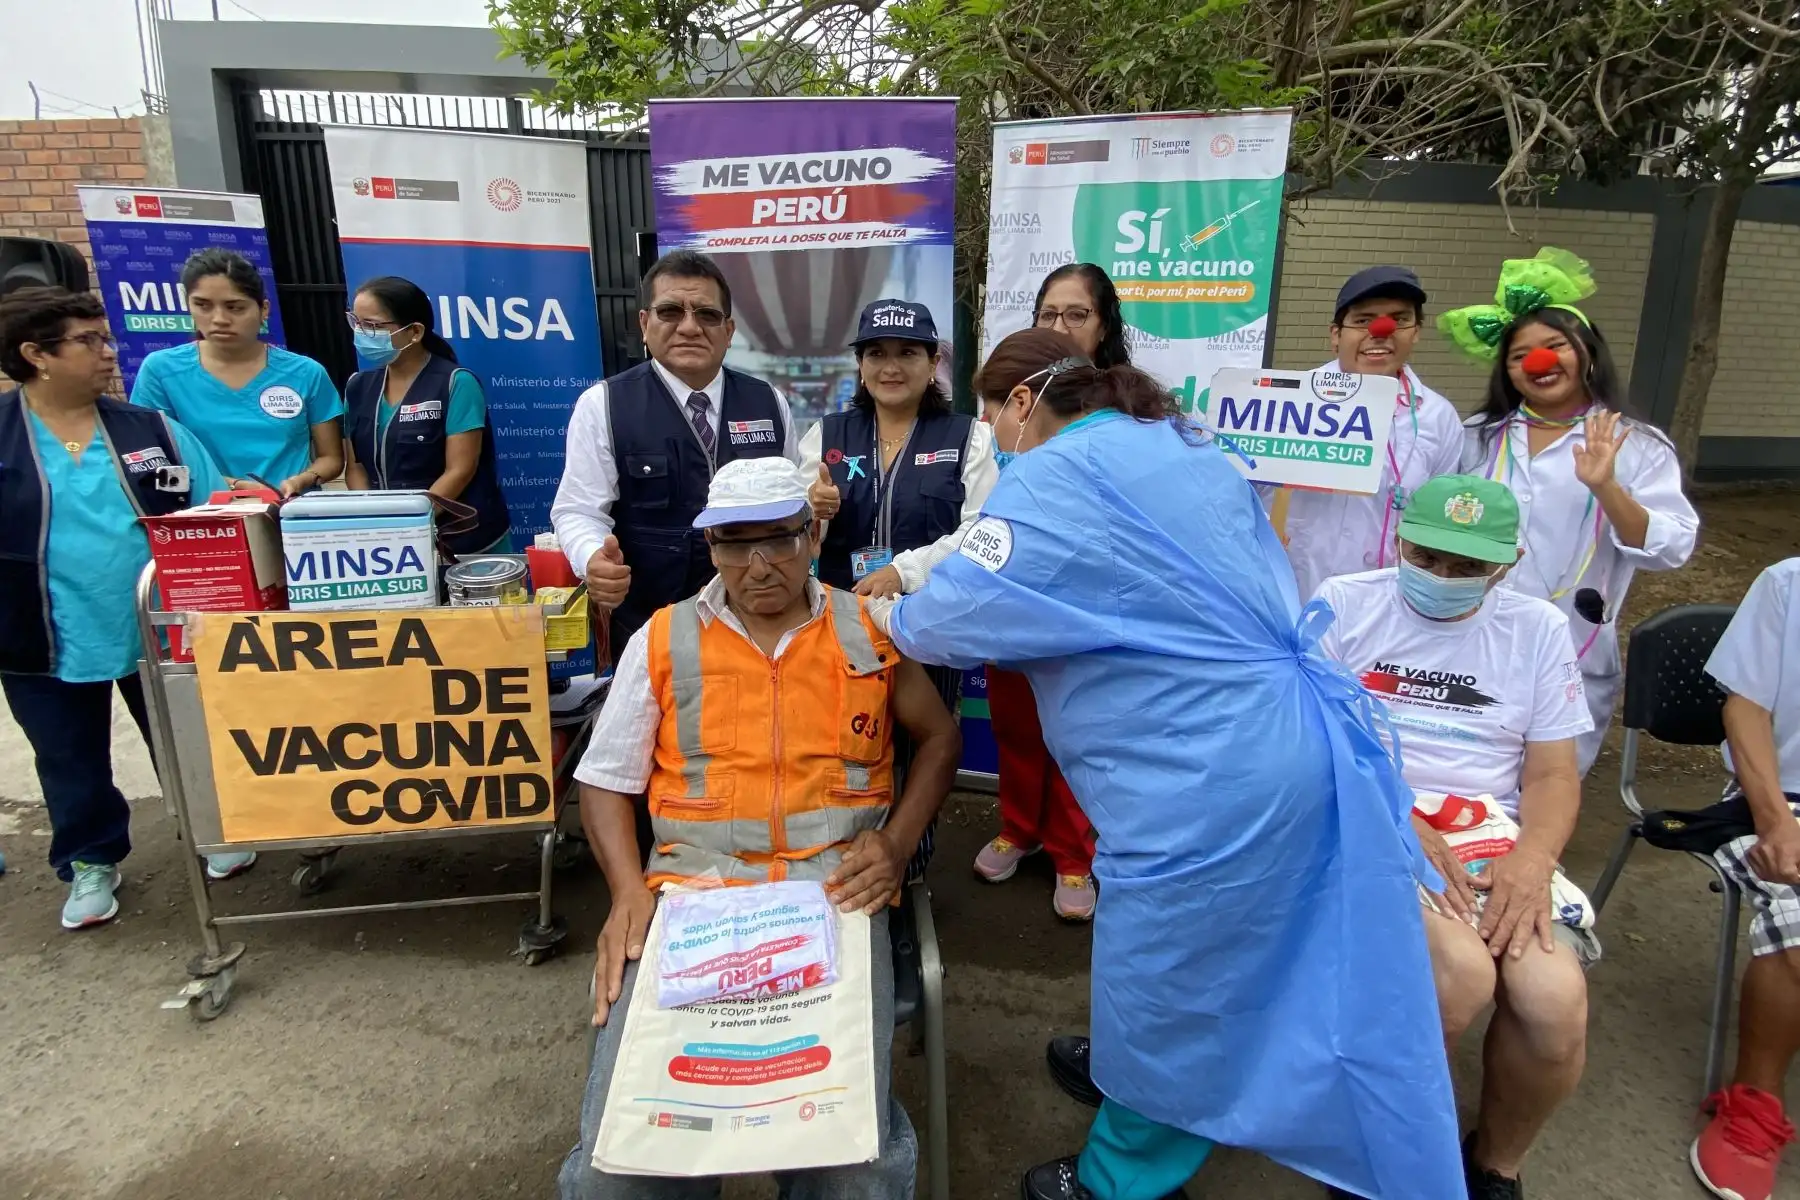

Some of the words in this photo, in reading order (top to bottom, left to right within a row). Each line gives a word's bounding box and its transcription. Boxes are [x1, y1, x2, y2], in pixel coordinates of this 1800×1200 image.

[1152, 139, 1190, 150] Siempre
[1165, 148, 1190, 157] pueblo
[702, 163, 749, 188] ME
[757, 156, 892, 185] VACUNO
[527, 190, 576, 199] BICENTENARIO
[752, 187, 847, 225] PERÚ
[990, 212, 1041, 227] MINSA
[706, 235, 769, 248] COMPLETA
[772, 235, 787, 245] LA
[791, 232, 825, 243] DOSIS
[828, 231, 852, 243] QUE
[857, 230, 869, 240] TE
[871, 228, 907, 239] FALTA
[1007, 227, 1026, 235] LIMA
[1115, 208, 1171, 258] Sí,
[1111, 260, 1152, 277] me
[1157, 259, 1255, 277] vacuno
[1147, 287, 1166, 299] por
[1185, 287, 1206, 299] por
[1207, 286, 1218, 297] el
[1219, 285, 1247, 297] Perú
[131, 317, 178, 330] DIRIS
[430, 295, 575, 341] INSA
[872, 311, 914, 328] Salud
[491, 376, 550, 388] Ministerio
[553, 377, 568, 387] de
[1323, 371, 1352, 381] DIRIS
[1315, 380, 1337, 388] LIMA
[1338, 381, 1357, 389] SUR
[1217, 396, 1373, 441] MINSA
[497, 426, 555, 437] Ministerio
[730, 432, 749, 445] DIRIS
[748, 432, 766, 444] LIMA
[1272, 440, 1320, 459] LIMA
[1324, 446, 1366, 464] SUR
[502, 477, 560, 487] Ministerio
[175, 527, 237, 540] DESLAB
[972, 528, 1002, 551] DIRIS
[962, 538, 980, 554] LIMA
[979, 547, 1003, 566] SUR
[284, 545, 425, 582] MINSA
[287, 585, 332, 601] DIRIS
[337, 582, 383, 598] LIMA
[387, 578, 424, 594] SUR
[578, 658, 592, 667] de
[1373, 661, 1401, 676] ME
[1405, 666, 1477, 687] VACUNO
[430, 667, 532, 716] DE
[1395, 681, 1449, 700] PERÚ
[851, 711, 879, 740] G4S
[228, 718, 541, 777] VACUNA
[330, 772, 551, 826] COVID
[750, 914, 759, 923] y
[758, 904, 800, 918] seguras
[715, 915, 749, 928] salvan
[769, 915, 814, 928] vacunas
[720, 928, 731, 938] la
[733, 923, 767, 937] contra
[668, 932, 719, 952] COVID-19
[718, 956, 773, 995] PERÚ
[776, 971, 805, 992] ME
[707, 1006, 718, 1016] la
[720, 1005, 767, 1017] COVID-19
[769, 1002, 789, 1012] son
[791, 992, 833, 1009] seguras
[757, 990, 800, 1005] vacunas
[710, 1019, 719, 1029] y
[720, 1017, 757, 1028] salvan
[760, 1014, 792, 1026] vidas.
[675, 1069, 692, 1078] más
[693, 1072, 724, 1080] cercano
[724, 1074, 731, 1082] y
[695, 1064, 720, 1073] Acude
[720, 1064, 729, 1072] al
[729, 1064, 753, 1074] punto
[753, 1065, 763, 1073] de
